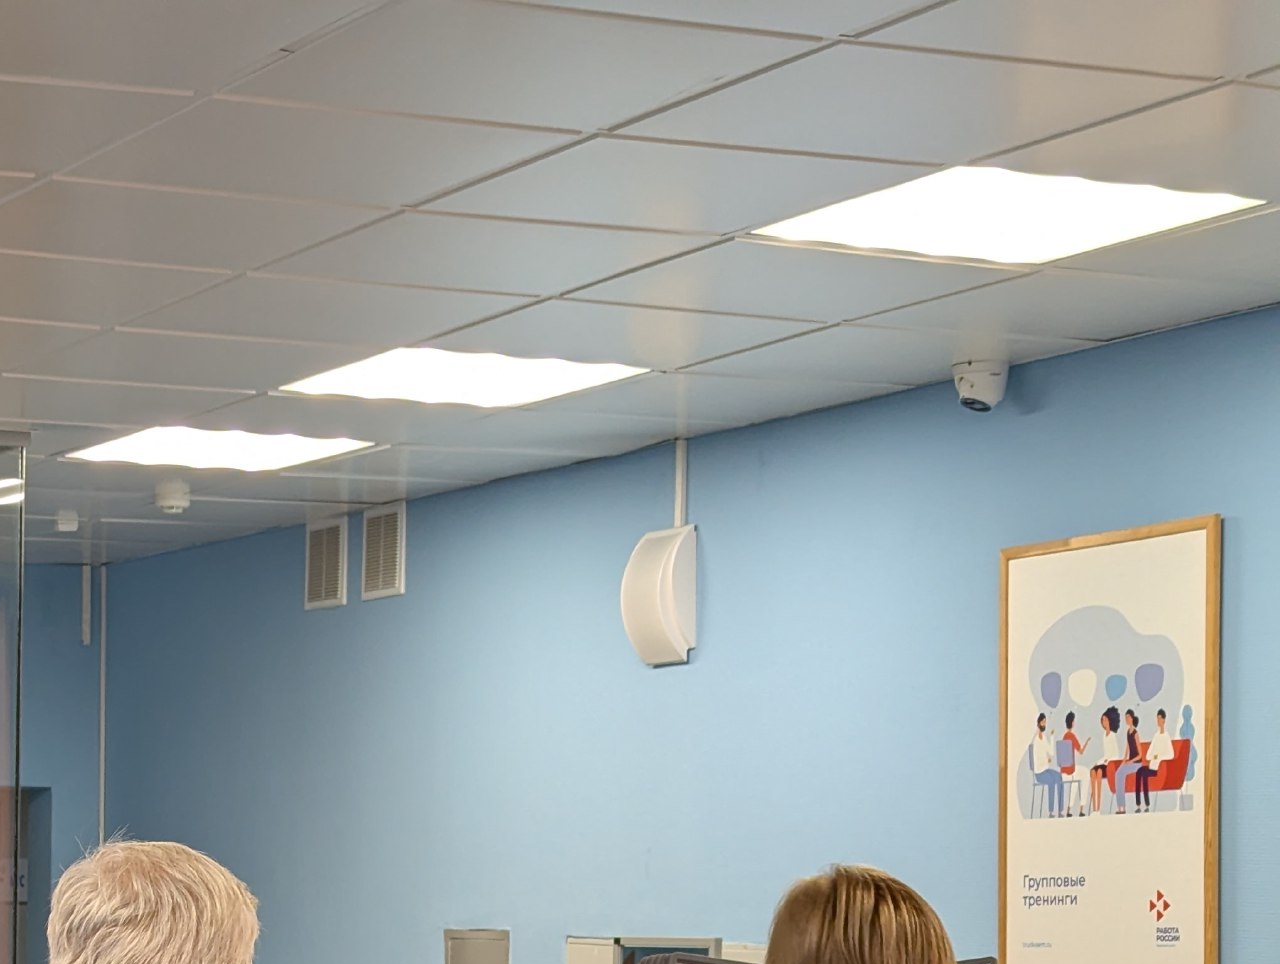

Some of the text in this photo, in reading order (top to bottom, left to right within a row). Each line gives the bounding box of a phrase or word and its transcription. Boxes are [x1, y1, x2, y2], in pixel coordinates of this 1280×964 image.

[1023, 874, 1086, 891] Групповые
[1023, 894, 1078, 909] тренинги
[1156, 934, 1181, 942] РОССИИ
